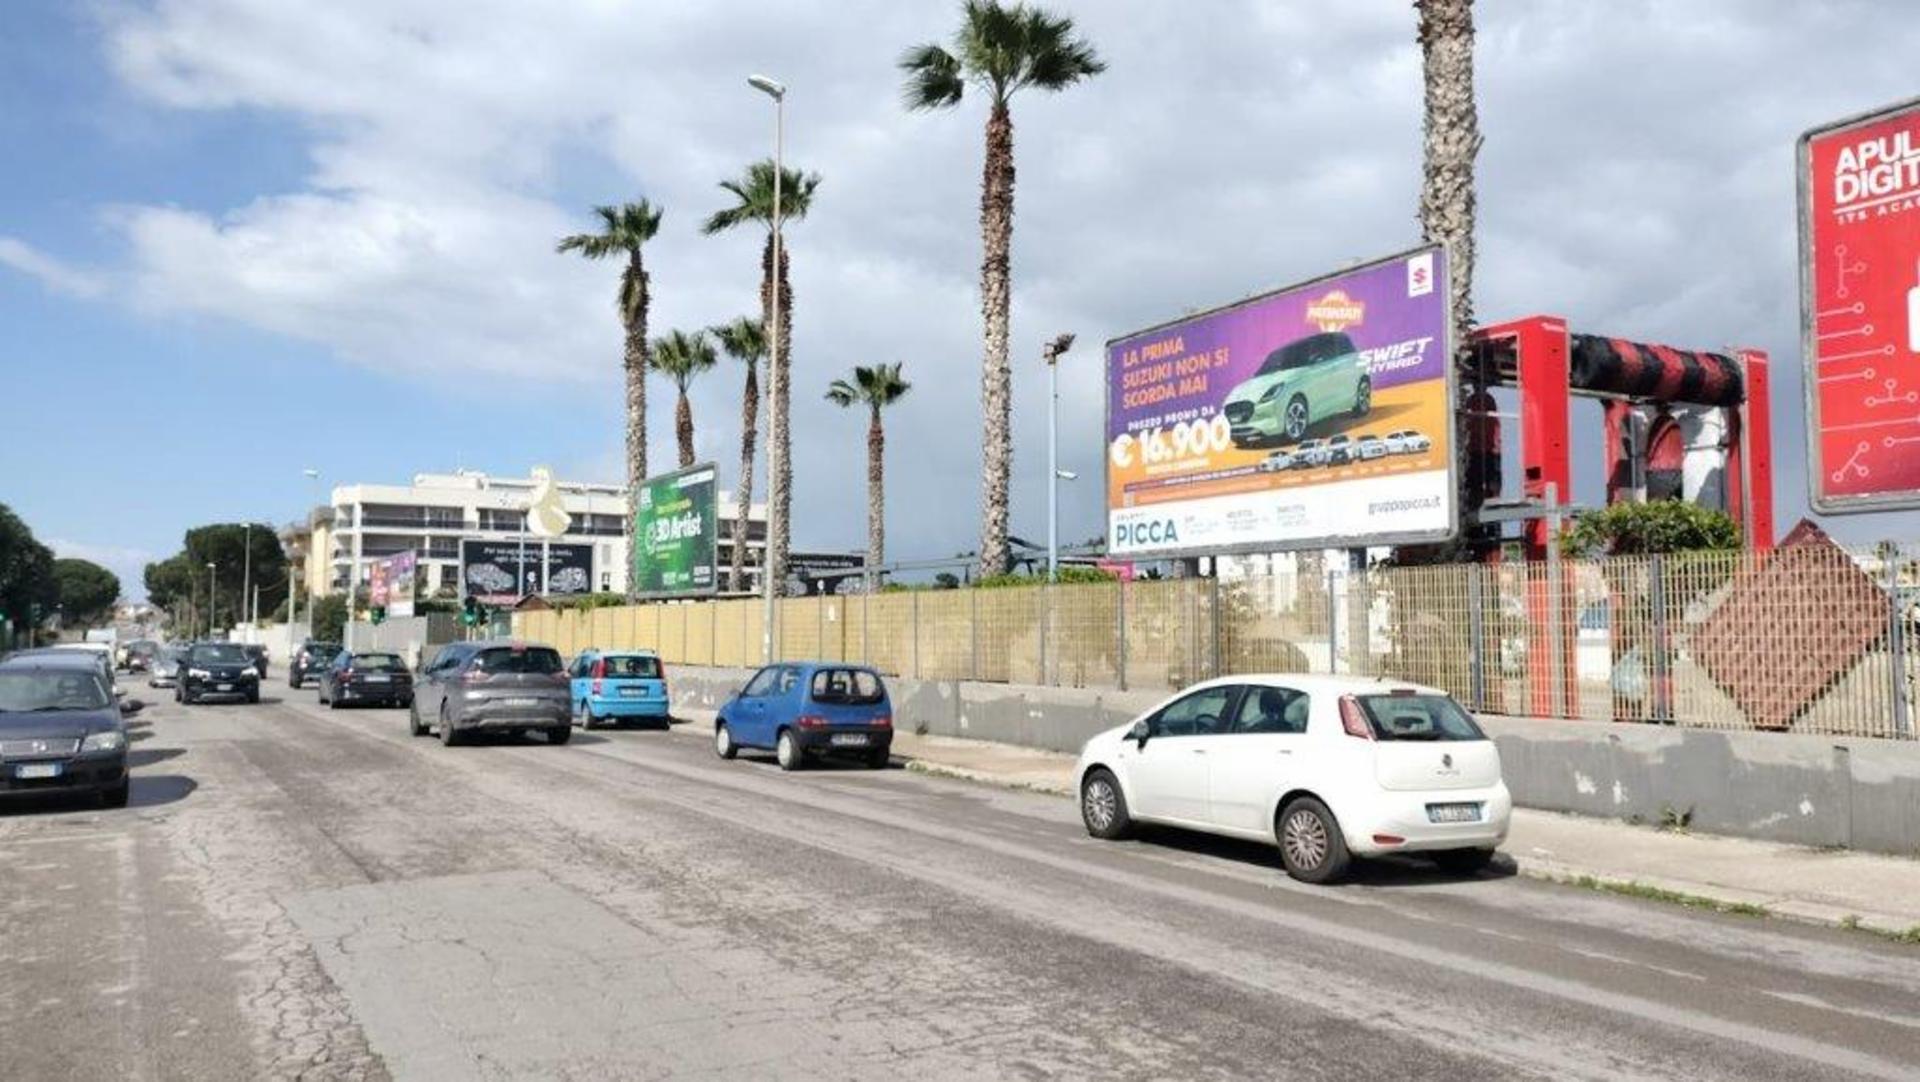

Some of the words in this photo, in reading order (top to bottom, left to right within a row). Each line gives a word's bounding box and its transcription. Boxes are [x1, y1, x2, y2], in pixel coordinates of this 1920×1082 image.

[1835, 130, 1920, 174] APUL
[1835, 157, 1920, 204] DIGIT
[1838, 210, 1868, 225] ITS
[1123, 350, 1138, 368] LA
[1142, 336, 1184, 362] PRIMA
[1356, 336, 1434, 367] SWIFT
[1366, 355, 1423, 375] HYBRID
[1123, 361, 1171, 389] SUZUKI
[1176, 351, 1210, 376] NON
[1214, 346, 1229, 367] SI
[1123, 382, 1175, 409] SCORDA
[1179, 375, 1207, 396] MAI
[1128, 417, 1161, 432] PREZZO
[1165, 409, 1198, 423] PROMO
[1201, 406, 1215, 417] DA
[1111, 433, 1134, 468] €
[1139, 414, 1231, 464] 16.900
[655, 517, 670, 541] 3D
[671, 511, 702, 540] Artist
[1116, 518, 1180, 546] PICCA
